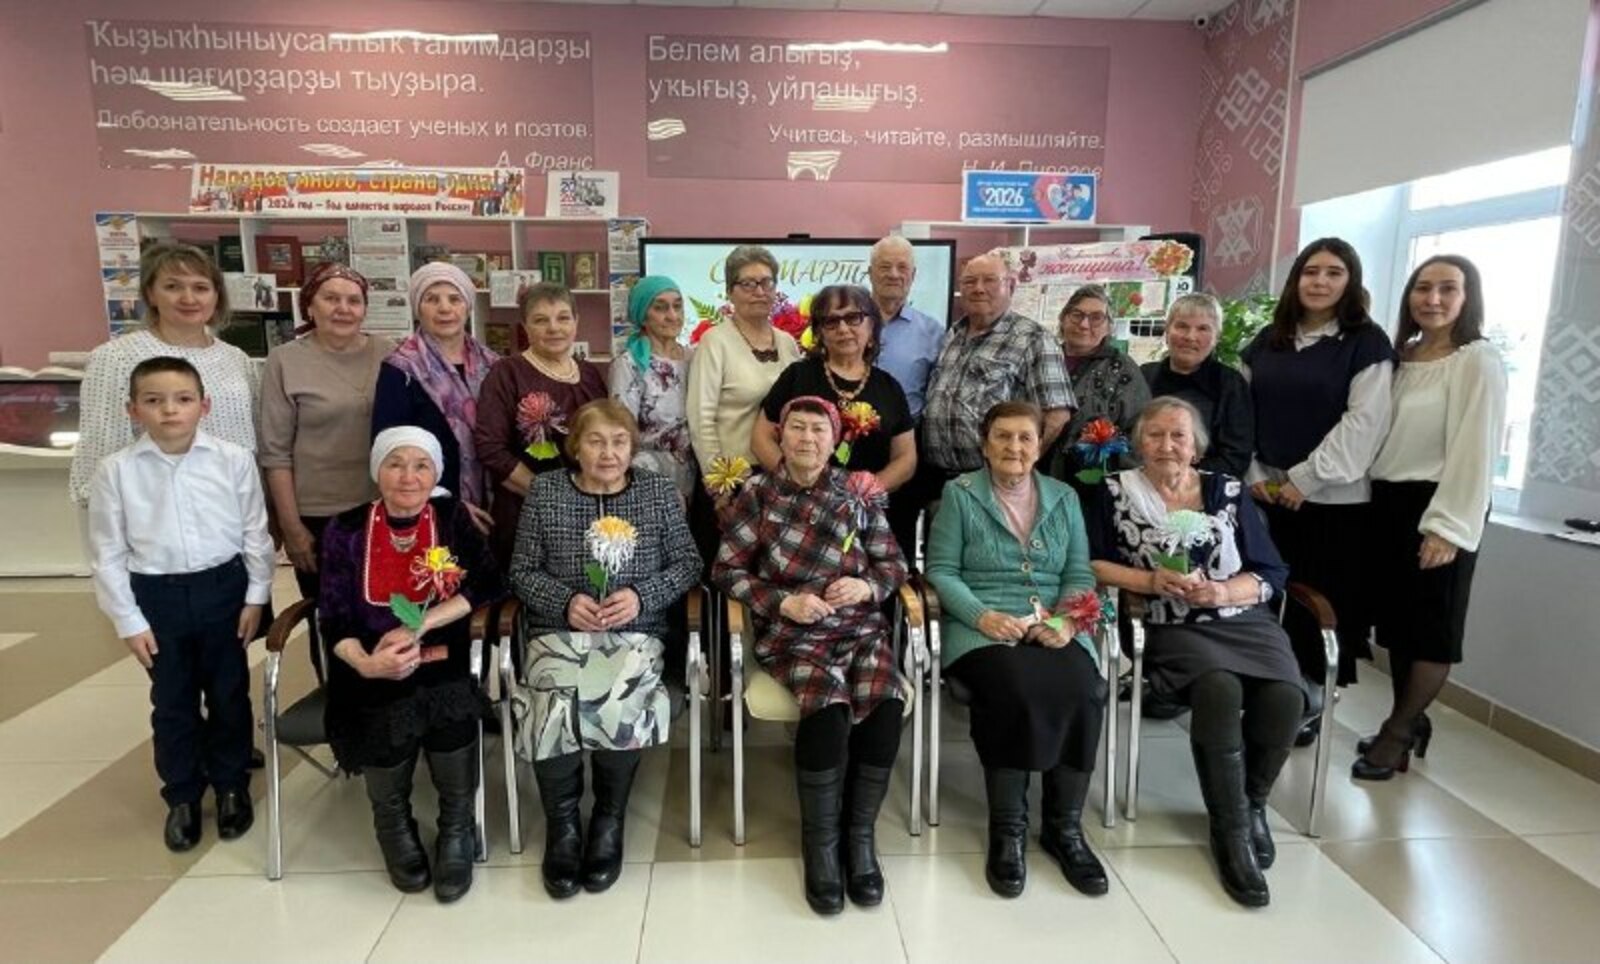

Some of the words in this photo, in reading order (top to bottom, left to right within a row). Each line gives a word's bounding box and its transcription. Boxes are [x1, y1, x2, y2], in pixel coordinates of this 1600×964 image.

[649, 36, 739, 62] Белем
[97, 109, 310, 132] Любознательность
[317, 118, 402, 136] создает
[409, 120, 489, 138] ученых
[496, 122, 507, 137] и
[515, 121, 593, 138] поэтов.
[769, 124, 859, 146] Учитесь,
[866, 127, 952, 148] читайте,
[958, 130, 1106, 151] размышляйте.
[525, 150, 593, 174] Франс
[200, 165, 289, 191] Народов
[368, 173, 438, 193] страна
[985, 187, 1025, 208] 2026
